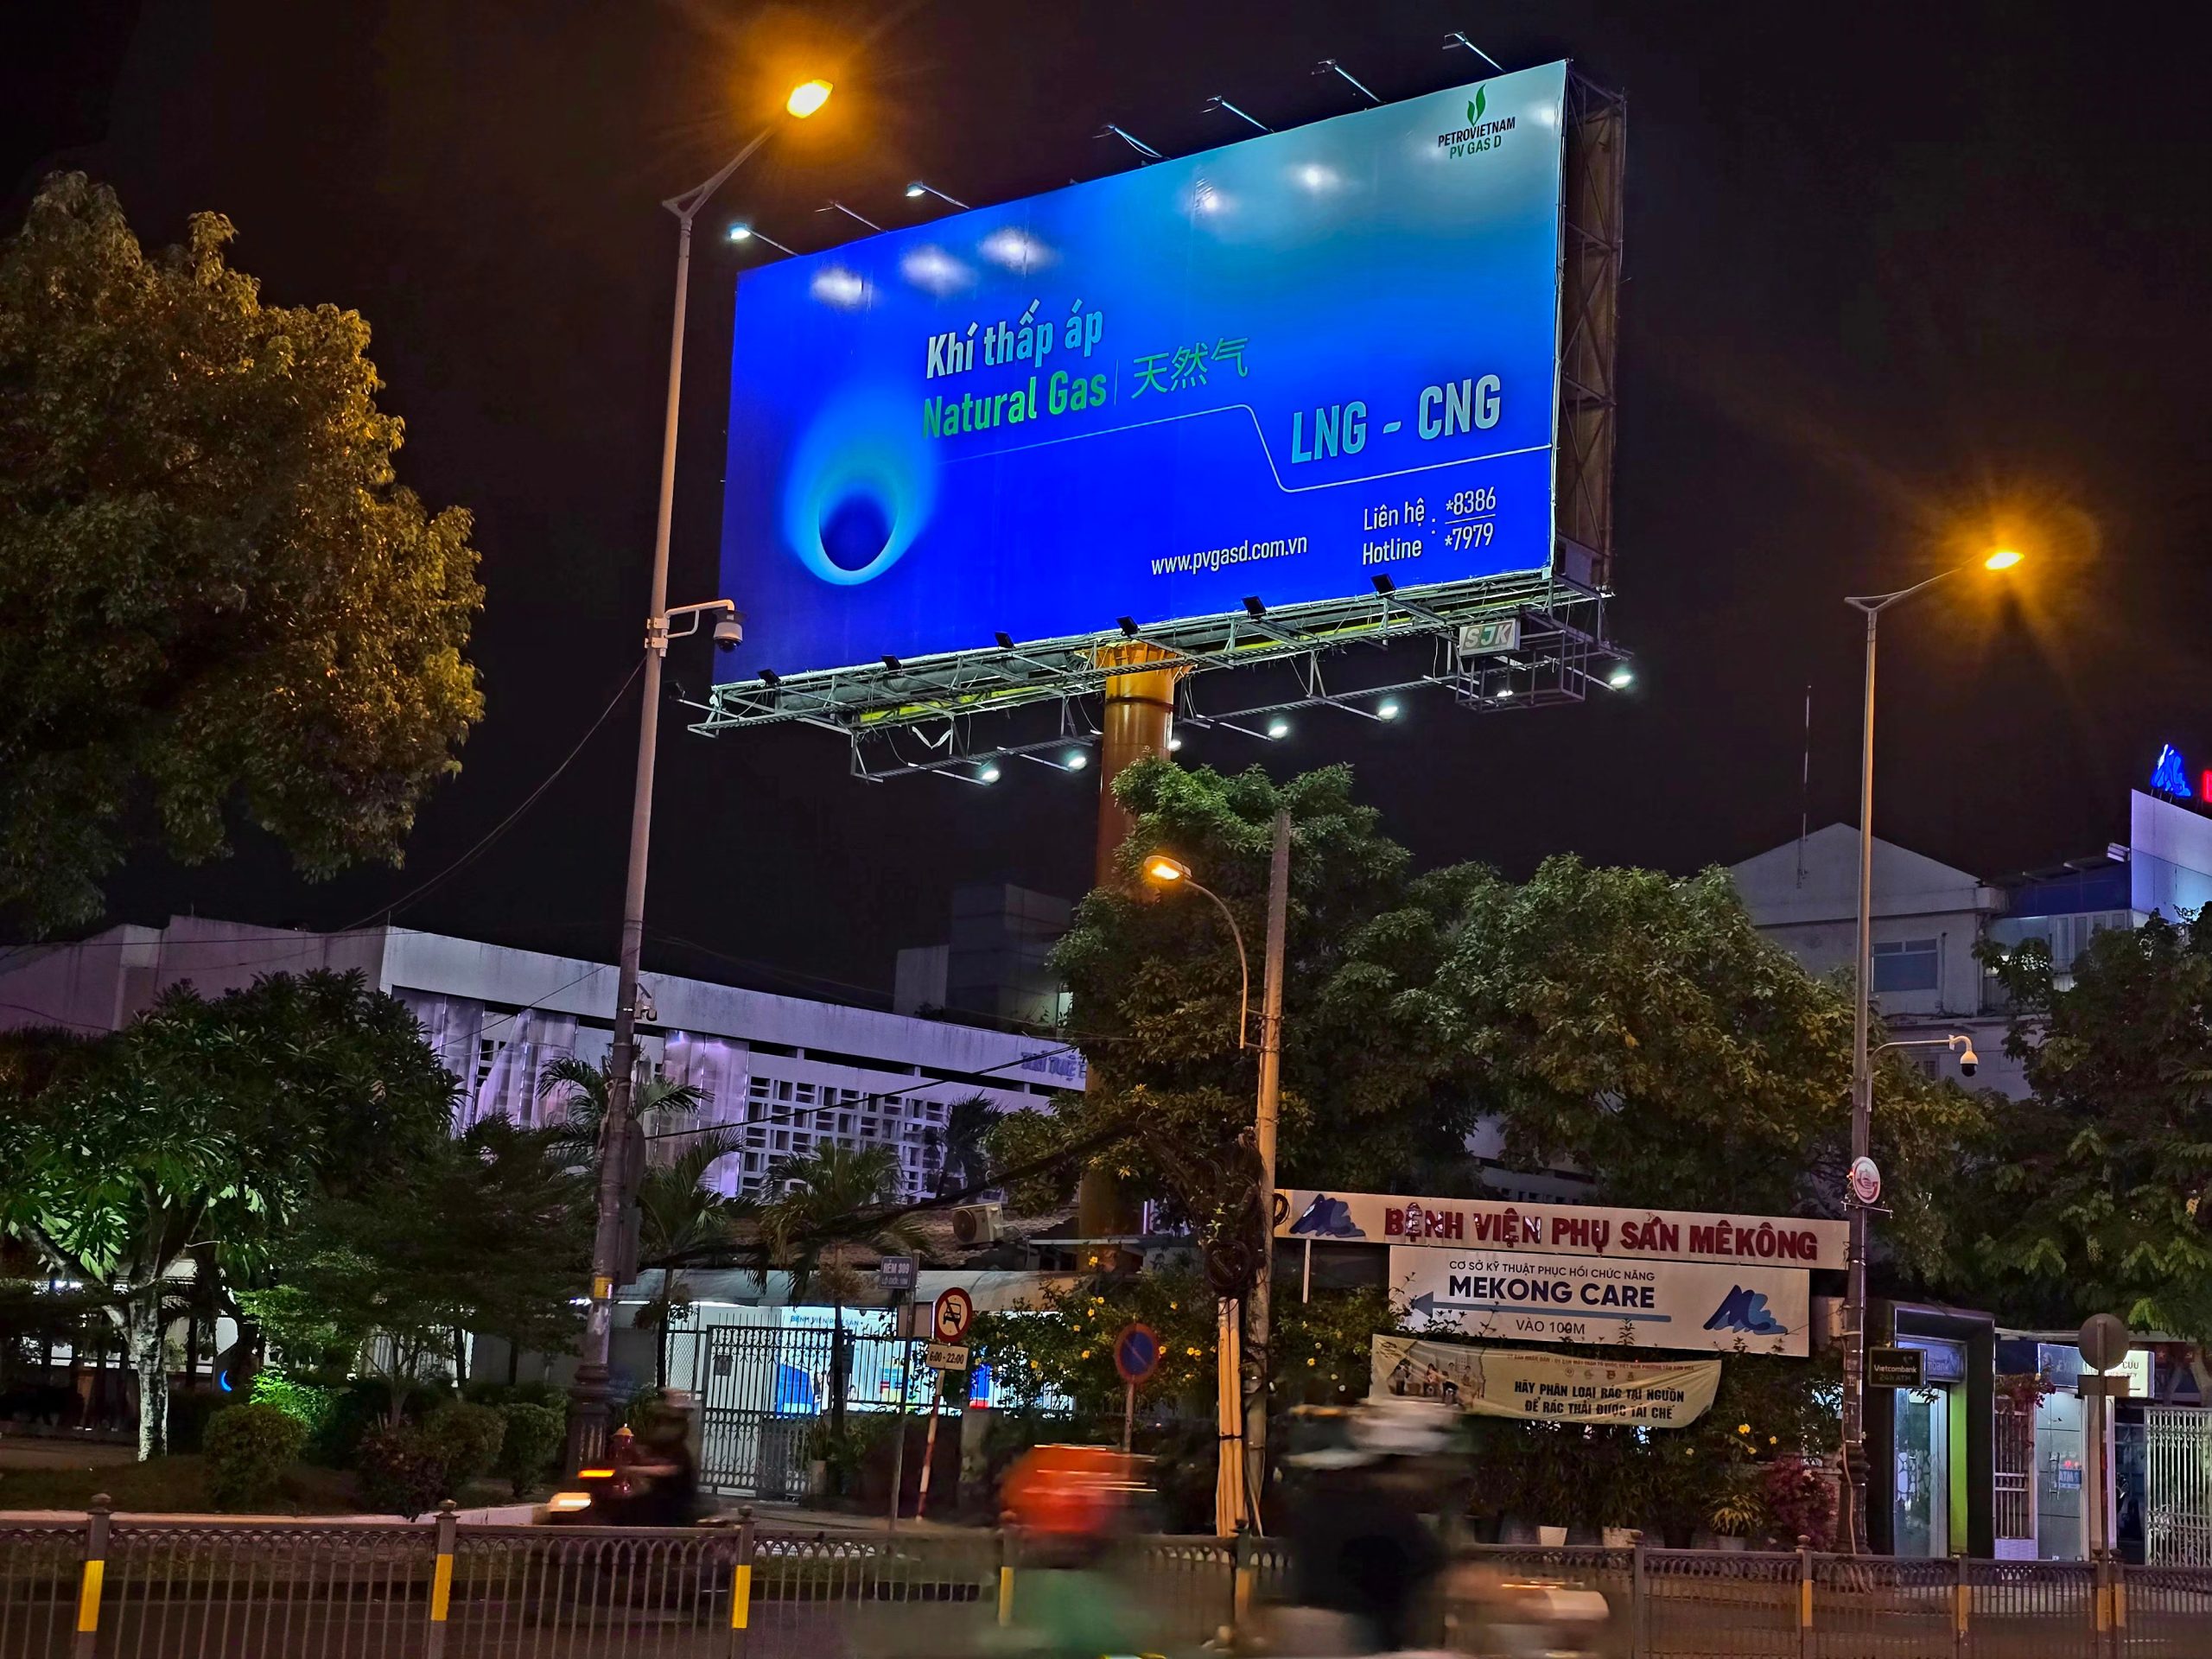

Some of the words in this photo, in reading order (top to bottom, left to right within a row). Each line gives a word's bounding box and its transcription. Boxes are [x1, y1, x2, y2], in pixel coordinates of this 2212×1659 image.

[1438, 116, 1516, 148] PETROVIETNAM
[1449, 143, 1465, 160] PV
[1467, 137, 1491, 156] GAS
[1493, 135, 1502, 149] D
[926, 321, 979, 379] Khí
[983, 298, 1054, 368] thấp
[1064, 298, 1103, 358] áp
[1130, 337, 1250, 399] 天然气
[922, 376, 1038, 440] Natural
[1048, 370, 1107, 416] Gas
[1291, 400, 1367, 464] LNG
[1382, 421, 1402, 434] -
[1418, 373, 1501, 441] CNG
[1363, 503, 1399, 531] Liên
[1403, 497, 1426, 528] hệ
[1151, 535, 1308, 575] www.pvgasd.com.vn
[1362, 537, 1422, 566] Hotline
[1465, 624, 1511, 648] SJK
[1384, 1202, 1464, 1242] BỆNH
[1473, 1207, 1541, 1248] VIỆN
[1551, 1217, 1611, 1253] PHỤ
[1689, 1219, 1818, 1261] MÊKÔNG
[1449, 1261, 1466, 1270] CƠ
[1468, 1259, 1484, 1272] SỞ
[1486, 1260, 1500, 1272] KỸ
[1503, 1262, 1535, 1277] THUẬT
[1538, 1265, 1567, 1278] PHỤC
[1591, 1267, 1621, 1281] CHỨC
[1449, 1274, 1573, 1304] MEKONG
[1580, 1282, 1656, 1309] CARE
[1516, 1317, 1545, 1332] VÀO
[1549, 1321, 1585, 1335] 100M
[929, 1351, 942, 1362] 6:00
[946, 1353, 964, 1364] 22:00
[1873, 1363, 1917, 1374] Vietcombank
[1514, 1379, 1535, 1394] HÃY
[1539, 1383, 1567, 1396] PHÂN
[1572, 1386, 1596, 1400] LOẠI
[1600, 1384, 1622, 1399] RÁC
[1626, 1389, 1642, 1401] TẠI
[1646, 1387, 1684, 1402] NGUỒN
[1524, 1396, 1541, 1412] ĐỂ
[1542, 1399, 1564, 1413] RÁC
[1567, 1400, 1592, 1414] THẢI
[1596, 1403, 1626, 1417] ĐƯỢC
[1651, 1405, 1675, 1419] CHẾ
